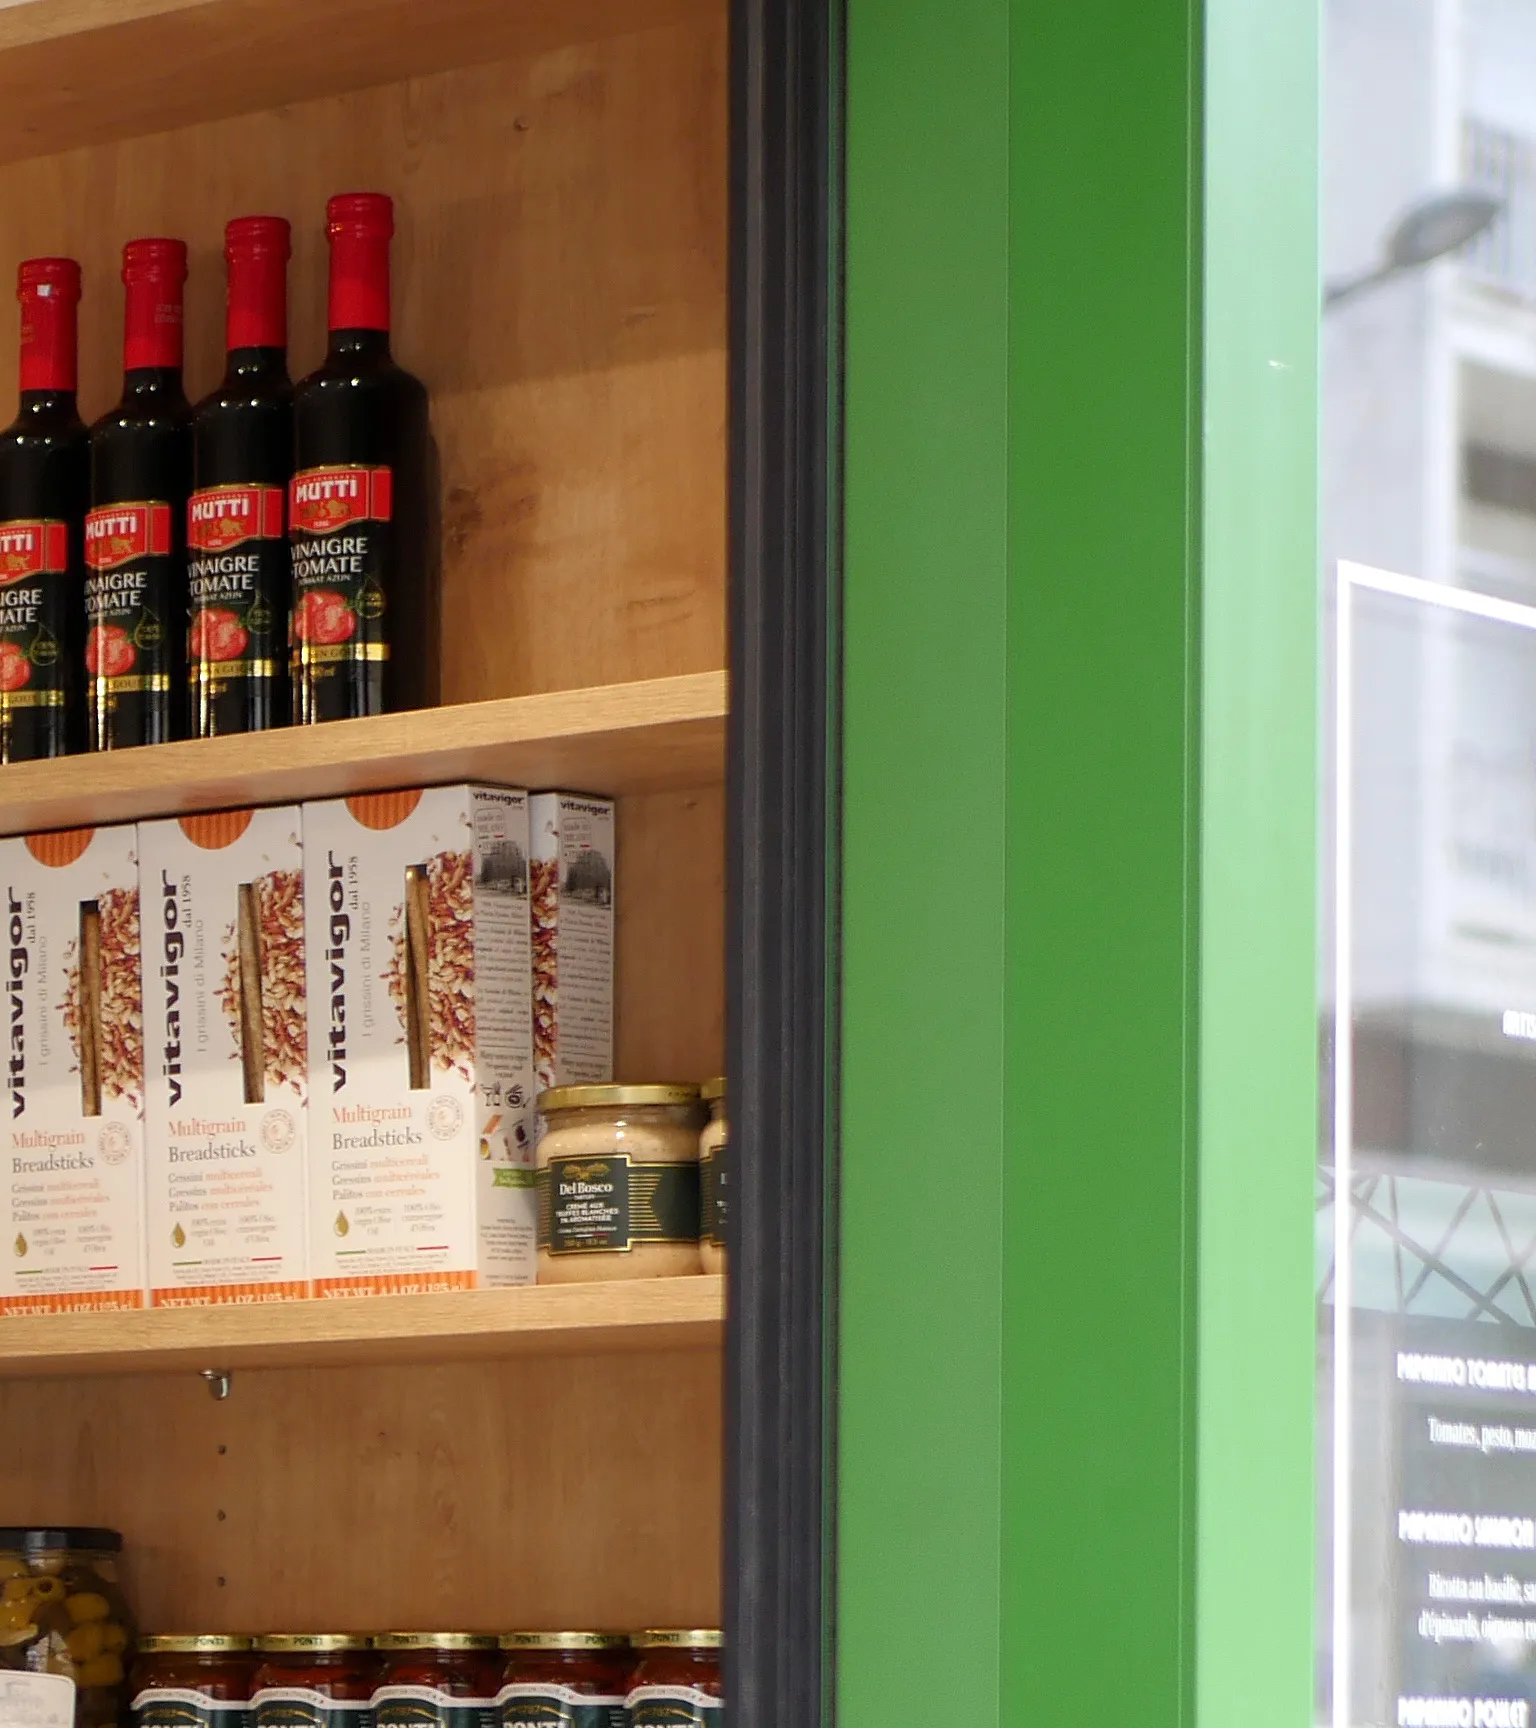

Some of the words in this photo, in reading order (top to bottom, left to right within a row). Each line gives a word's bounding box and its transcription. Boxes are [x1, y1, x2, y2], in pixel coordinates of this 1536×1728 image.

[296, 479, 358, 504] MUTTI
[192, 498, 249, 522] MUTTI
[85, 516, 138, 539] MUTTI
[291, 537, 369, 561] VINAIGRE
[187, 556, 260, 579] VINAIGRE
[473, 792, 524, 806] vitavigor
[560, 801, 610, 816] vitavigor
[349, 856, 358, 885] 1958
[182, 875, 191, 903] 1958
[349, 888, 358, 910] dal
[26, 892, 36, 920] 1958
[182, 906, 192, 928] dal
[26, 922, 36, 944] dal
[360, 902, 370, 951] Milano
[194, 920, 204, 968] Milano
[326, 851, 350, 1093] vitavigor
[161, 869, 184, 1107] vitavigor
[6, 886, 28, 1119] vitavigor
[333, 1104, 412, 1126] Multigrain
[12, 1130, 86, 1149] Multigrain
[168, 1118, 246, 1138] Multigrain
[333, 1127, 422, 1150] Breadsticks
[12, 1152, 94, 1174] Breadsticks
[168, 1141, 256, 1163] Breadsticks
[559, 1183, 576, 1196] Del
[578, 1182, 614, 1194] Bosco
